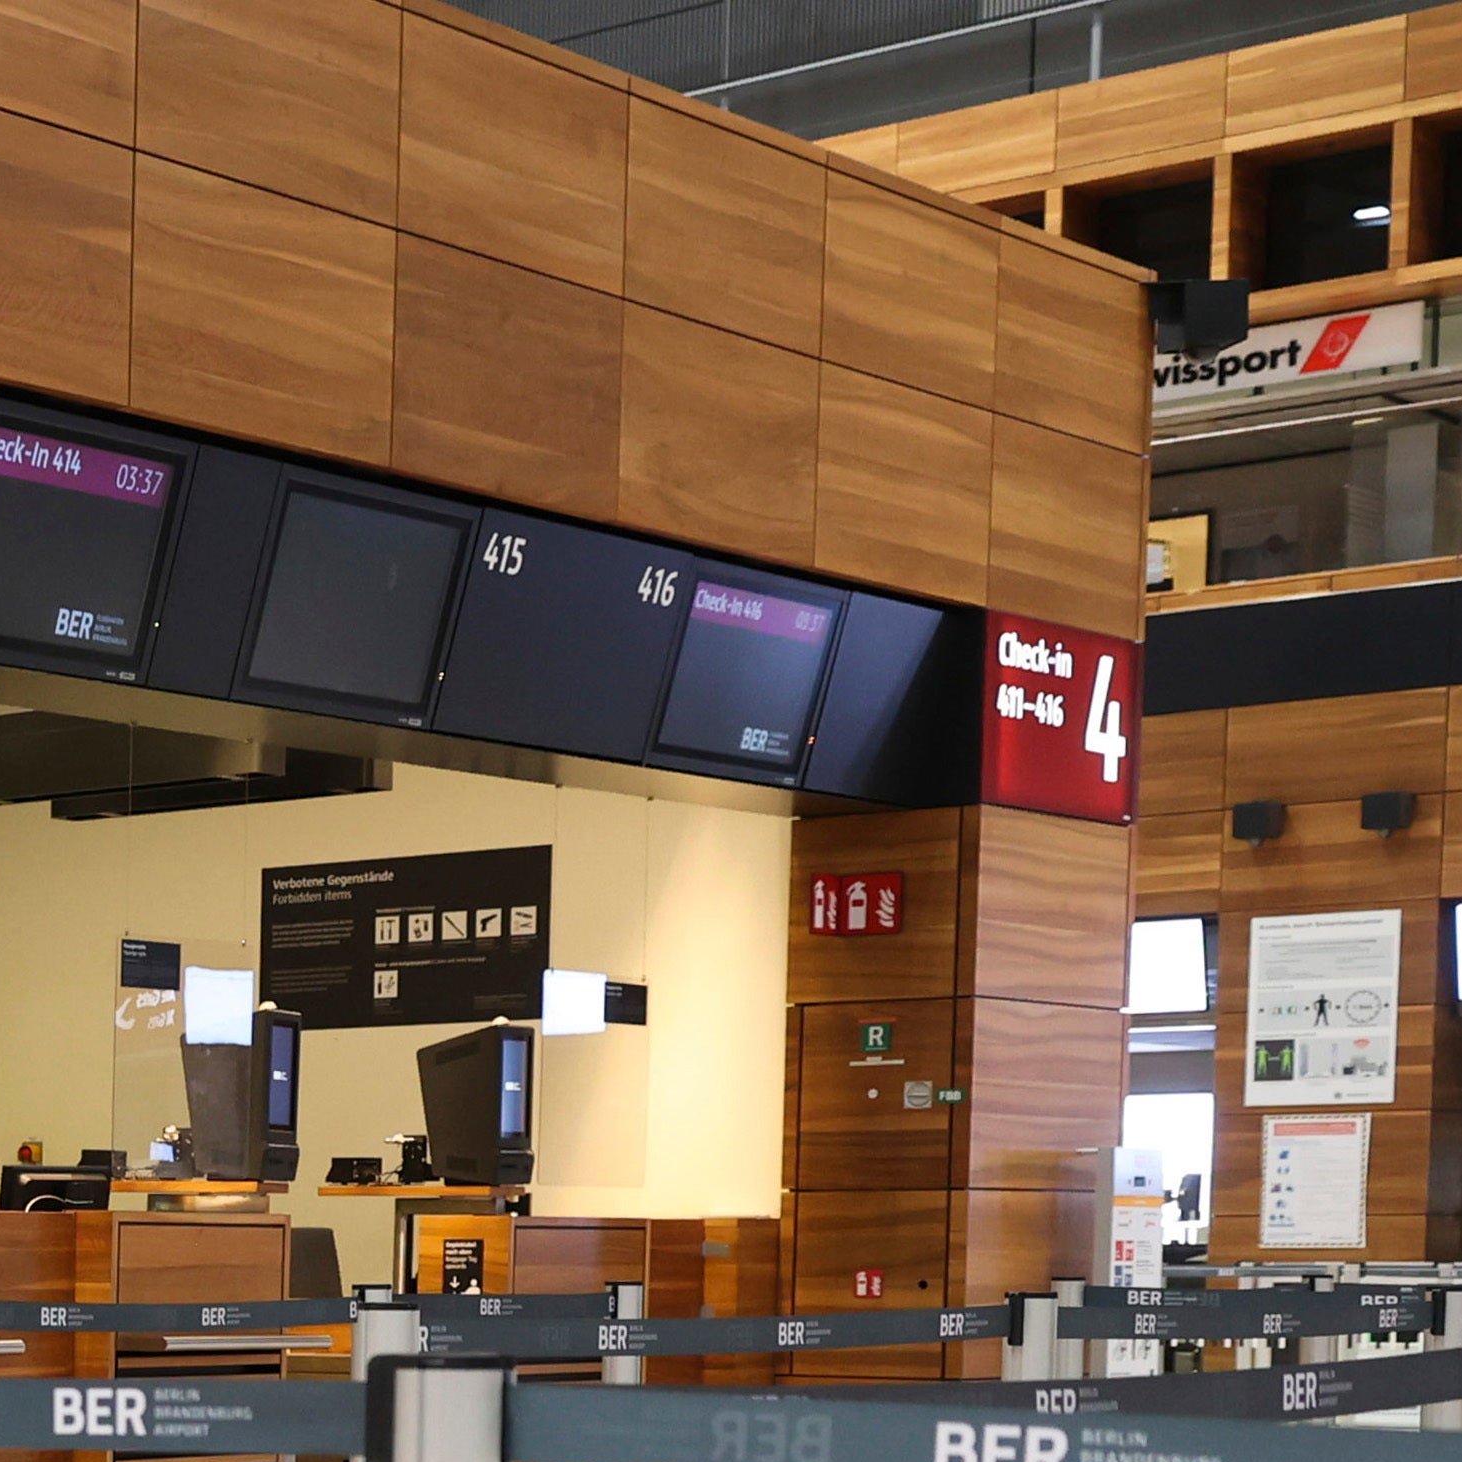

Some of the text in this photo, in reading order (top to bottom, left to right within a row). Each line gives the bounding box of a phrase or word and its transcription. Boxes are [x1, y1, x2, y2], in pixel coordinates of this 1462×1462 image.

[52, 447, 81, 475] 414
[116, 464, 165, 495] 03:37
[483, 532, 527, 575] 415
[637, 566, 679, 607] 416
[54, 608, 94, 640] BER
[998, 630, 1074, 680] Check-in
[1084, 653, 1128, 784] 4
[272, 870, 395, 891] Verbotene Gegenstände
[272, 888, 353, 905] Forbidden items
[868, 1025, 885, 1047] R
[480, 1298, 501, 1316] BER
[1127, 1290, 1162, 1306] BER
[40, 1306, 67, 1327] BER
[201, 1307, 226, 1327] BER
[939, 1313, 965, 1337] BER
[1134, 1313, 1157, 1335] BER
[1262, 1313, 1282, 1334] BER
[1378, 1308, 1398, 1328] BER
[598, 1325, 628, 1350] BER
[778, 1321, 805, 1346] BER
[154, 1389, 200, 1402] BERLIN
[1283, 1371, 1317, 1411] BER
[53, 1387, 147, 1436] BER
[154, 1406, 252, 1421] BRANDENBURG
[154, 1422, 209, 1437] AIRPORT
[1081, 1428, 1149, 1447] BERLIN
